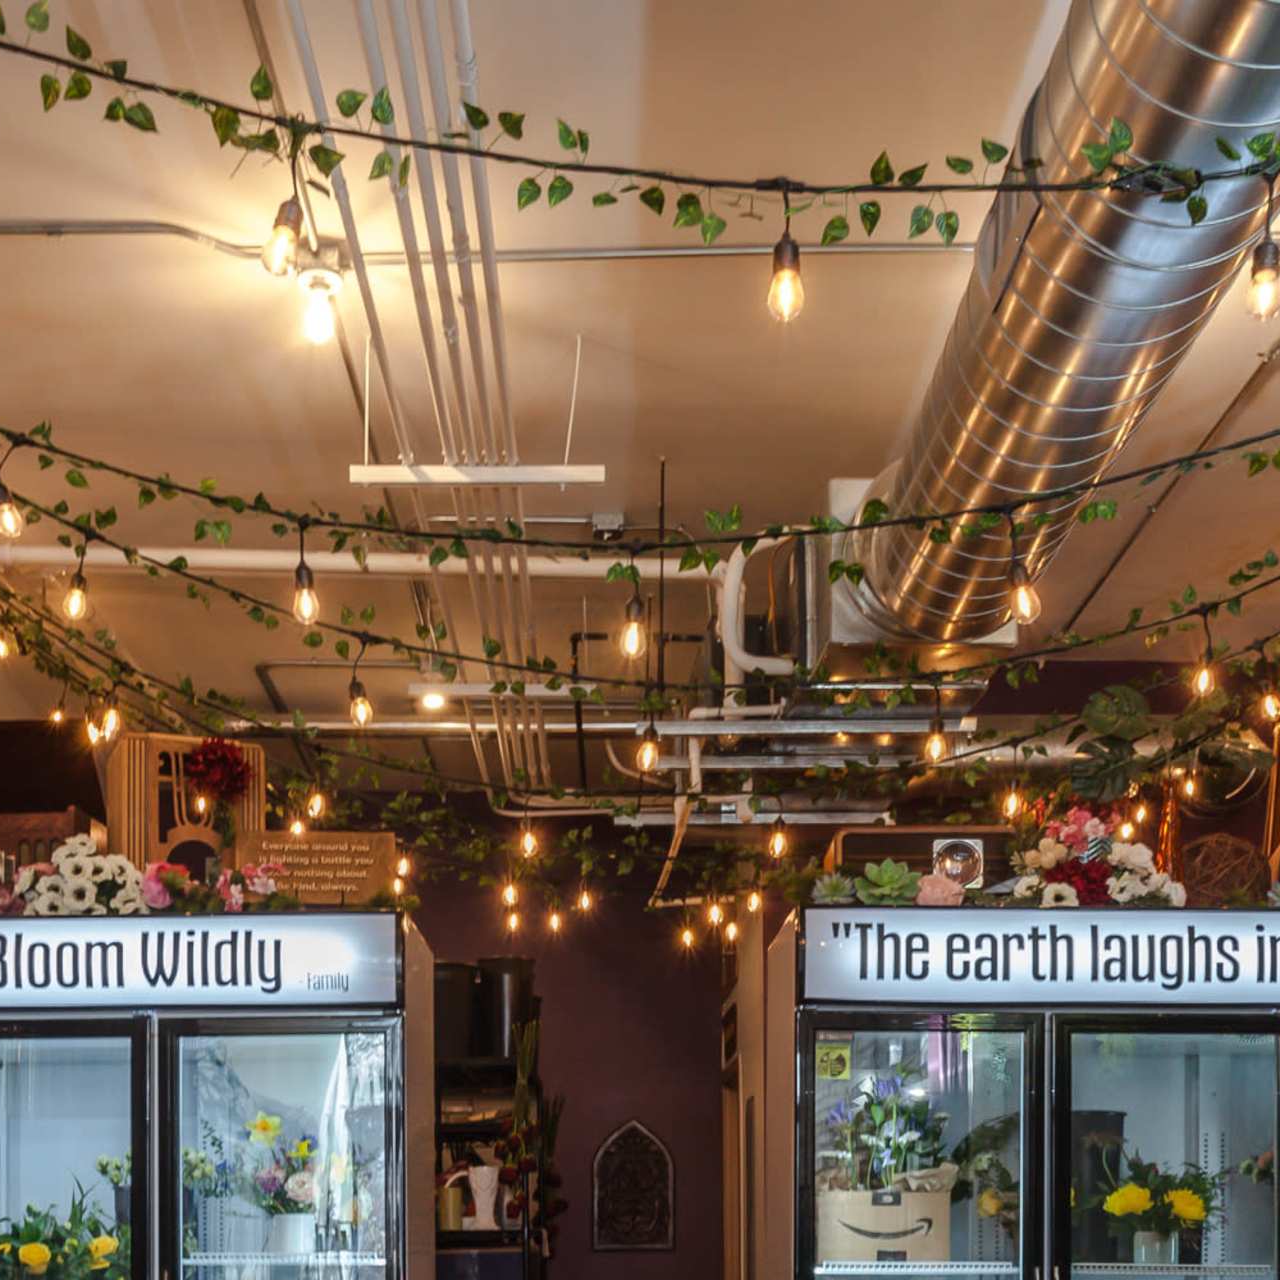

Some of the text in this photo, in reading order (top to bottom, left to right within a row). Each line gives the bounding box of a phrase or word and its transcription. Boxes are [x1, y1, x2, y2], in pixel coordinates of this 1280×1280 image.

[262, 841, 370, 853] Everyone around you
[269, 855, 309, 865] fighting
[320, 855, 352, 865] battle
[355, 858, 374, 866] you
[294, 868, 333, 879] nothing
[142, 931, 281, 993] Wildly
[832, 922, 928, 980] "The
[947, 925, 1073, 981] earth
[1091, 925, 1239, 990] laughs
